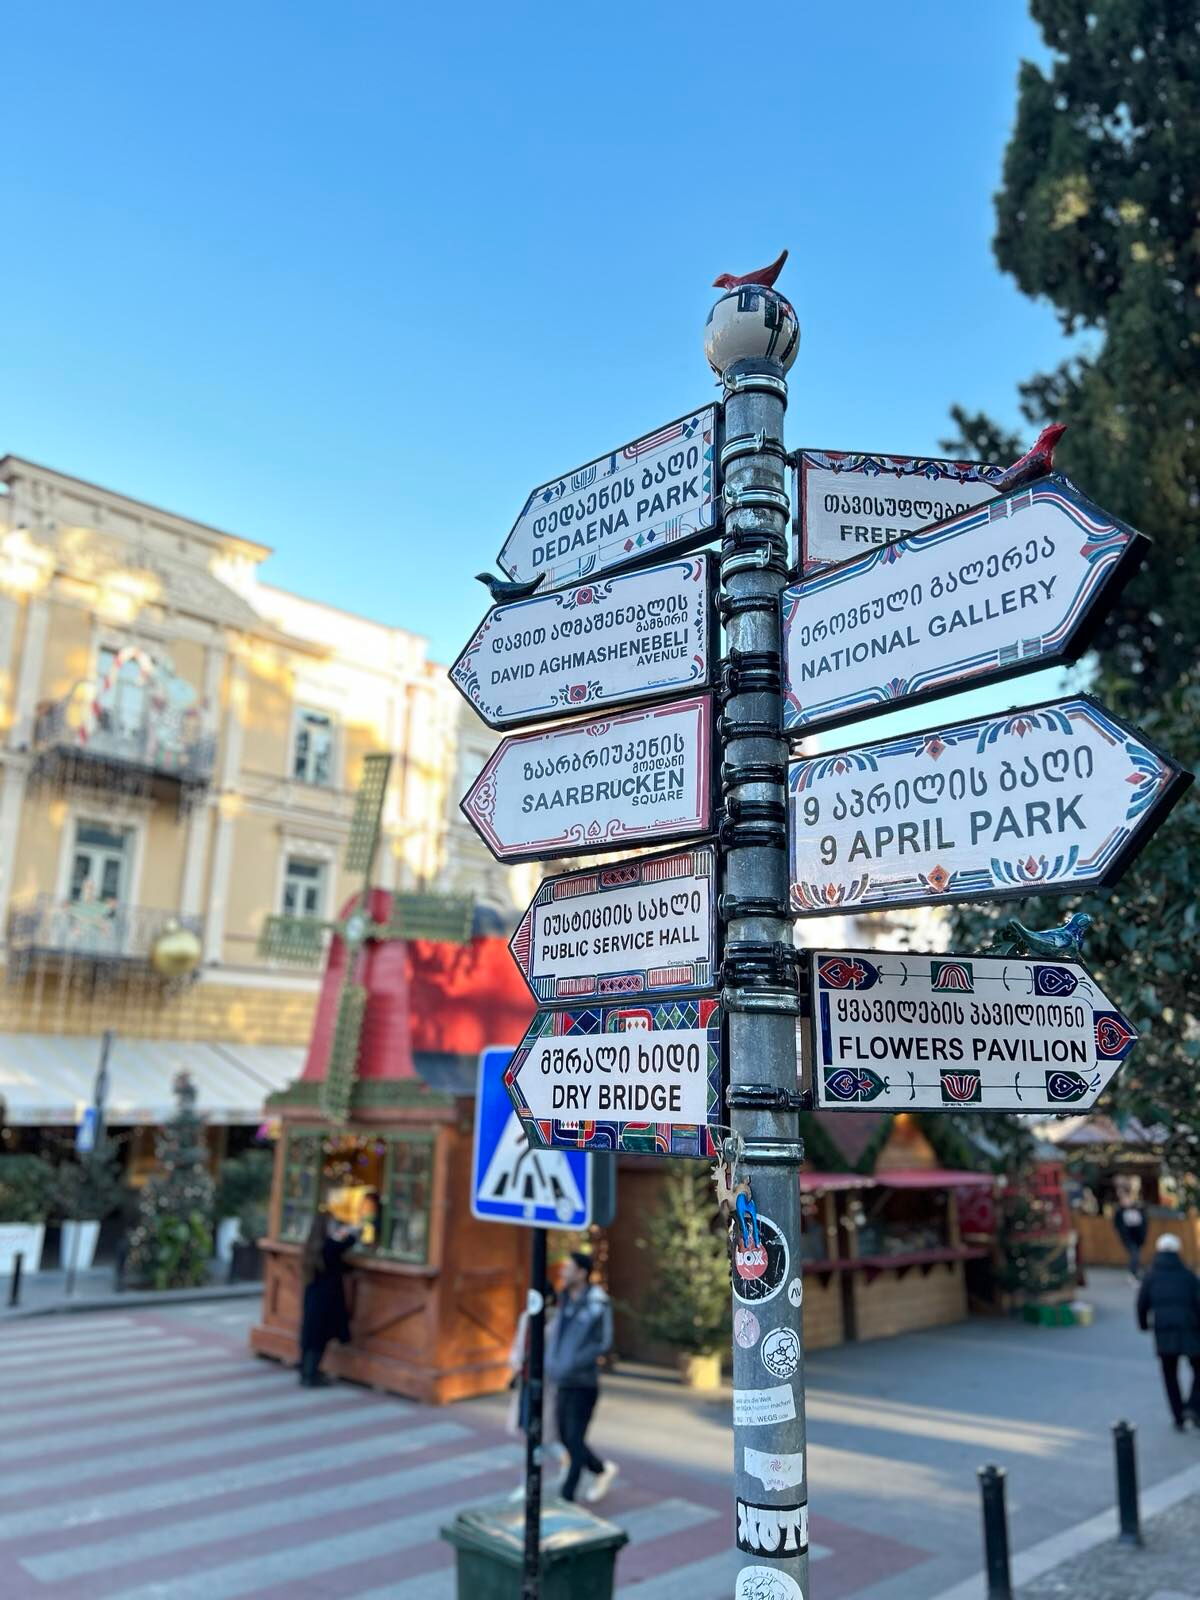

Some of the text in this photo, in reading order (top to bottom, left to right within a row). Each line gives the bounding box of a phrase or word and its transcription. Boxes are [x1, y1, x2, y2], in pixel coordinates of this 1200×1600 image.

[532, 445, 699, 539] დედაენის ბაღი
[824, 493, 972, 521] თავისუფლები
[532, 476, 699, 568] DEDAENA PARK
[800, 535, 1056, 648] ეროვნული გალერეა
[492, 594, 688, 654] დავით აღმაშენებლის
[636, 611, 688, 633] გამზირი
[801, 576, 1057, 682] NATIONAL GALLERY
[491, 629, 689, 685] DAVID AGHMASHENEBELI
[636, 647, 688, 667] AVENUE
[523, 733, 685, 781] ზაარბრიუკენის
[632, 755, 684, 774] მოედანი
[632, 790, 683, 807] SQUARE
[803, 744, 1094, 827] 9 აპრილის ბაღი
[819, 794, 1087, 866] 9 APRIL PARK
[543, 889, 701, 937] იუსტიციის სახლი
[542, 926, 700, 961] PUBLIC SERVICE HALL
[837, 998, 1085, 1028] ყვავილების პავილიონი
[541, 1043, 700, 1075] მშრალი ხიდი
[839, 1036, 1088, 1063] FLOWERS PAVILION
[553, 1084, 681, 1112] DRY BRIDGE
